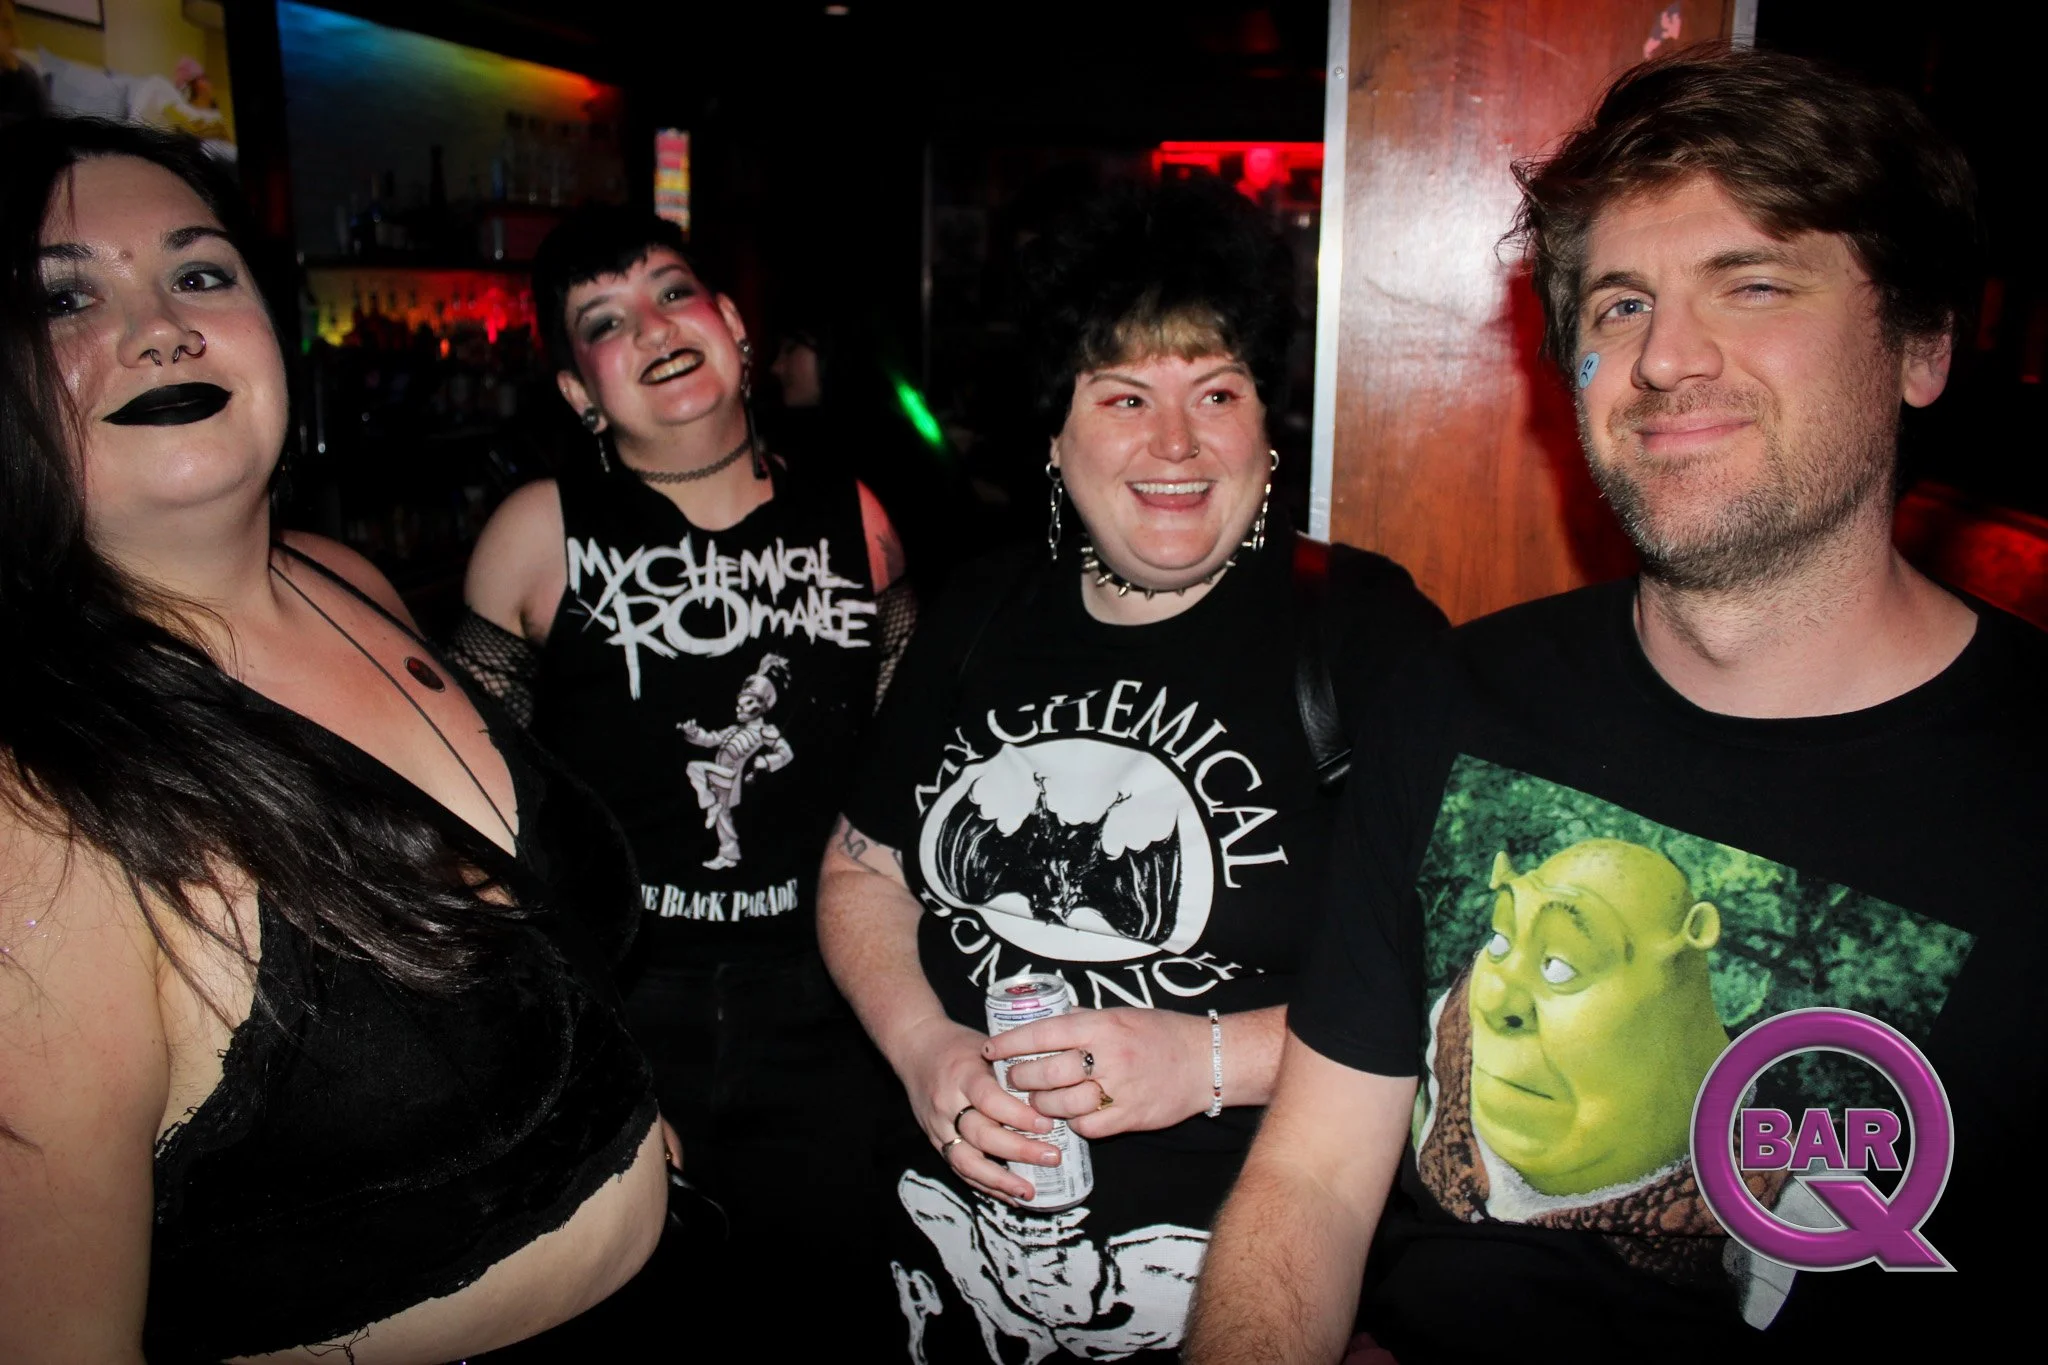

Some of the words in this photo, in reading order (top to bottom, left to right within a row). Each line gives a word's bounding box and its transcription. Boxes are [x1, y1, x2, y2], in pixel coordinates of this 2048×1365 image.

[634, 532, 864, 609] CHEMICAL
[914, 726, 984, 818] MY
[986, 678, 1289, 888] CHEMICAL
